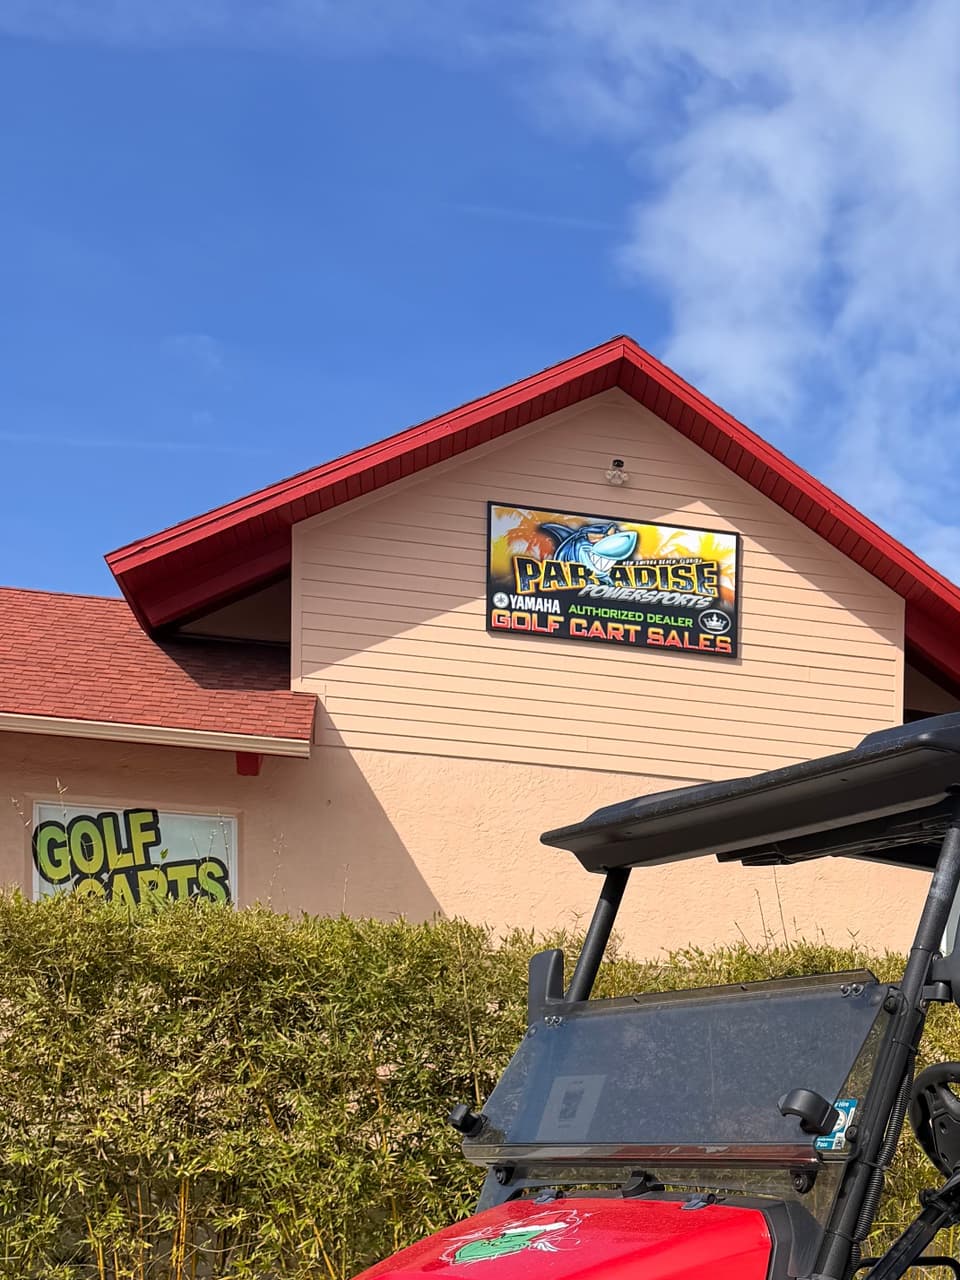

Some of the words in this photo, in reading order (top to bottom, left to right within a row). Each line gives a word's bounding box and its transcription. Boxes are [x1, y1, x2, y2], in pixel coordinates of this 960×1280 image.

[512, 556, 719, 597] PARADISE
[577, 584, 714, 609] POWERSPORTS
[491, 609, 565, 633] GOLF
[569, 617, 642, 643] CART
[647, 627, 732, 654] SALES
[509, 594, 561, 614] YAMAHA
[568, 604, 644, 622] AUTHORIZED
[647, 613, 694, 628] DEALER
[33, 809, 161, 884] GOLF
